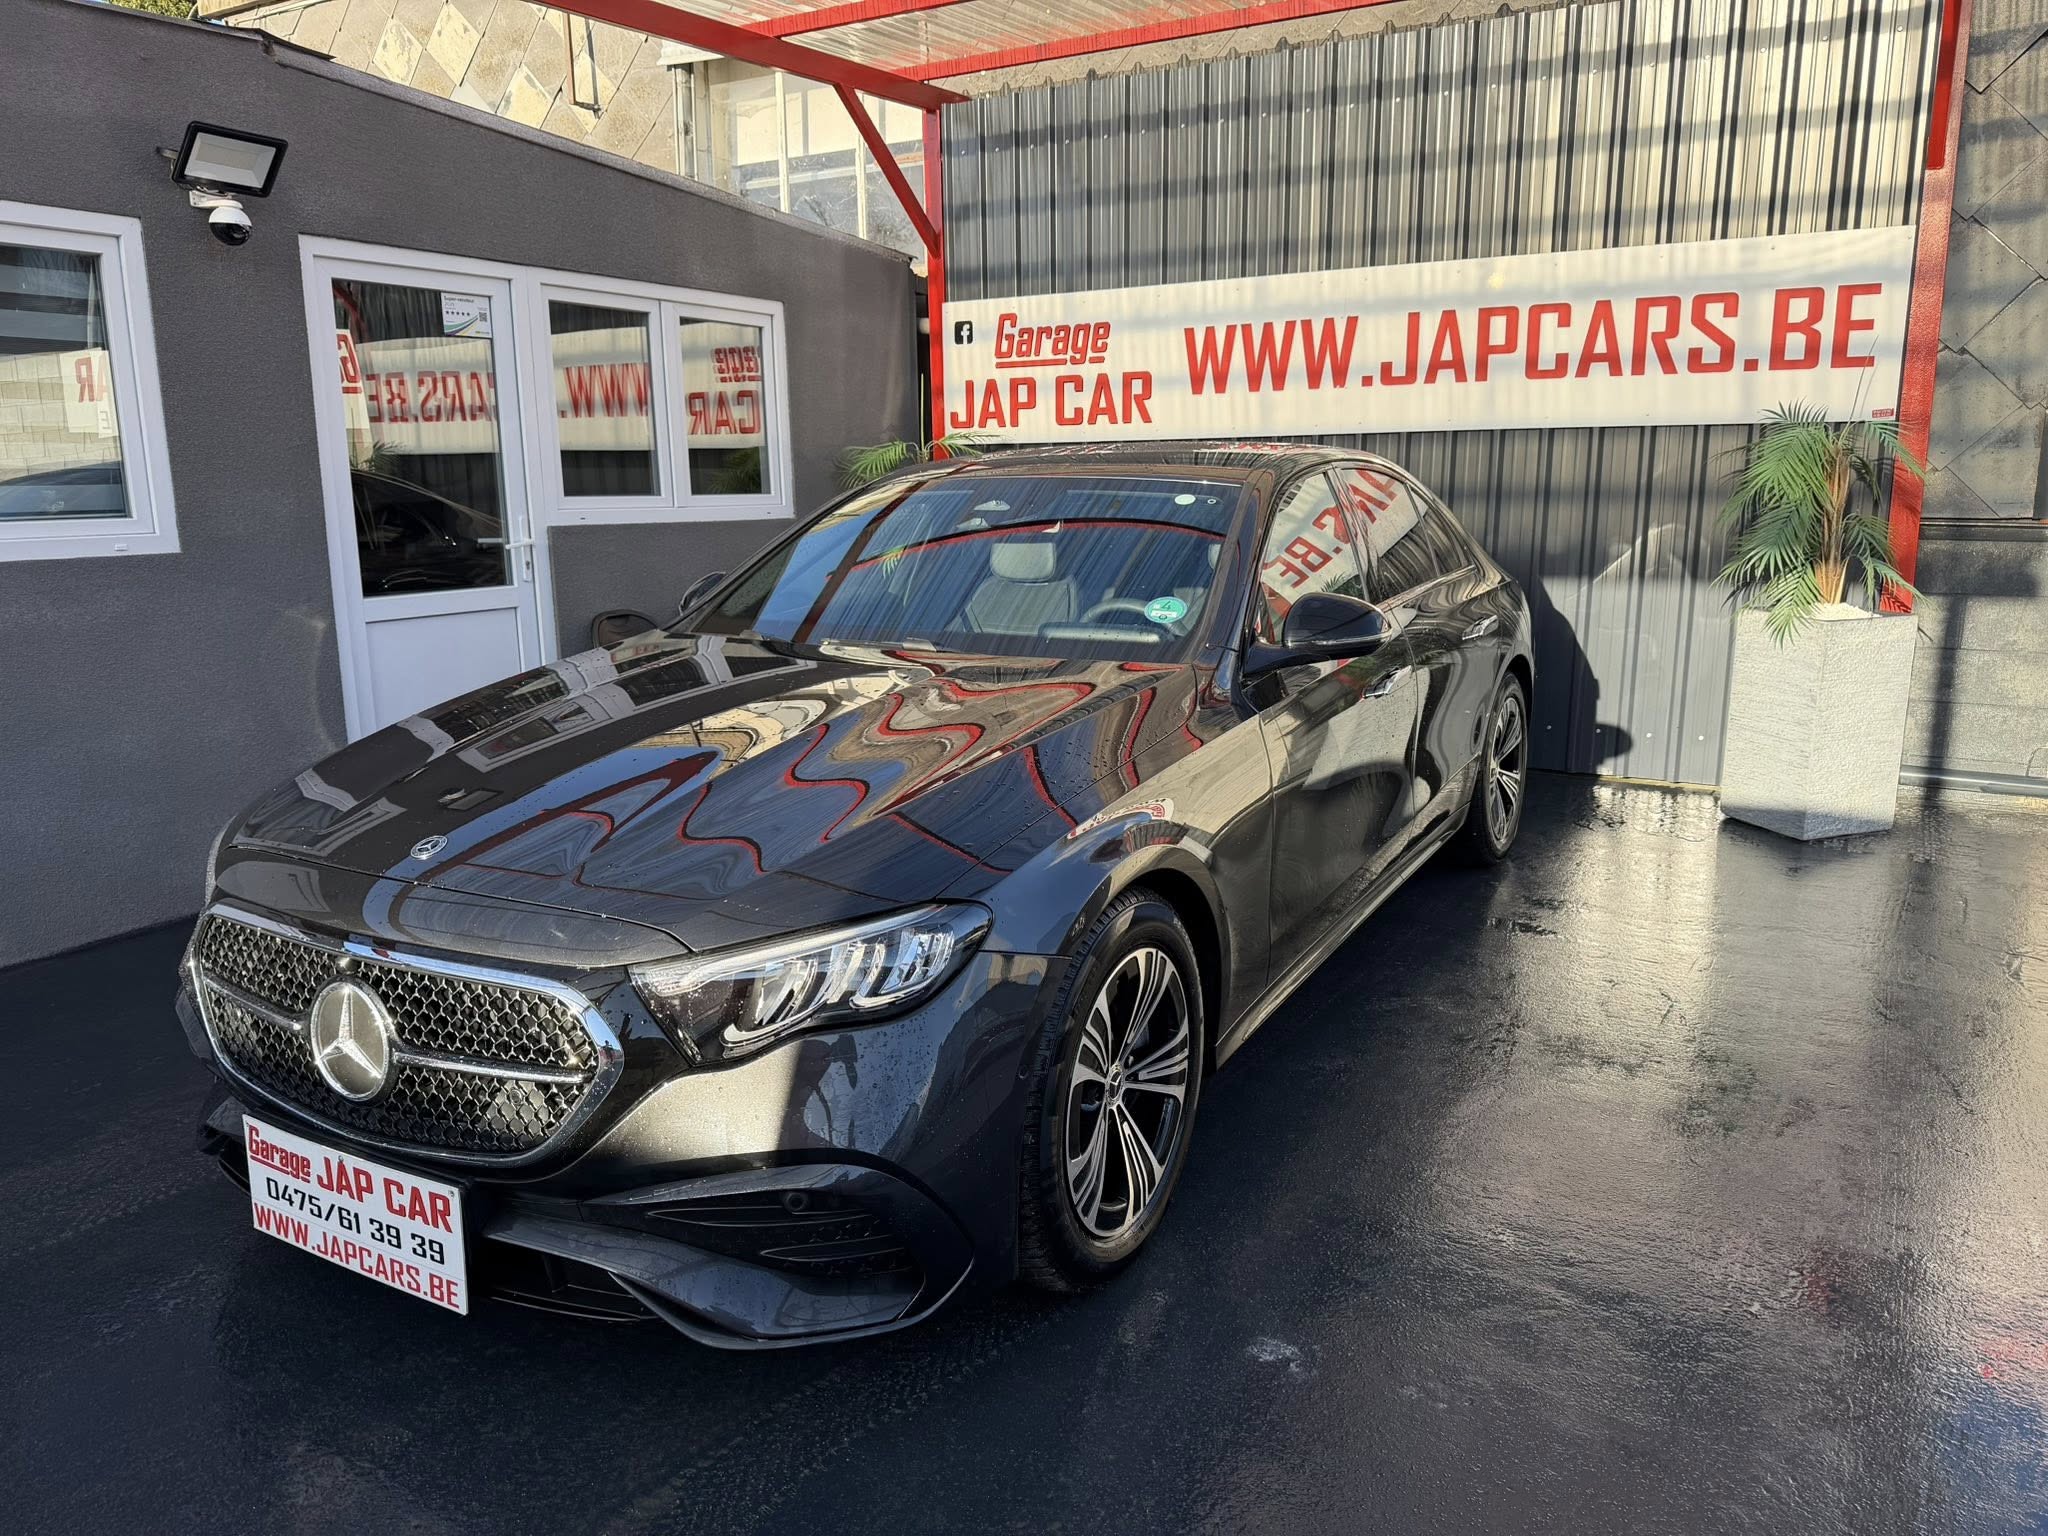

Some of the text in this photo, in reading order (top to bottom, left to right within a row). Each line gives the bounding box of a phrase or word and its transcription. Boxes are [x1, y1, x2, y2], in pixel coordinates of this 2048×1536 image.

[994, 313, 1111, 365] Garage
[1184, 283, 1883, 394] WWW.JAPCARS.BE
[950, 371, 1153, 429] JAP CAR
[249, 1125, 453, 1233] Garage JAP CAR
[266, 1177, 445, 1265] 0475/61 39 39
[254, 1203, 459, 1309] WWW.JAPCARS.BE
